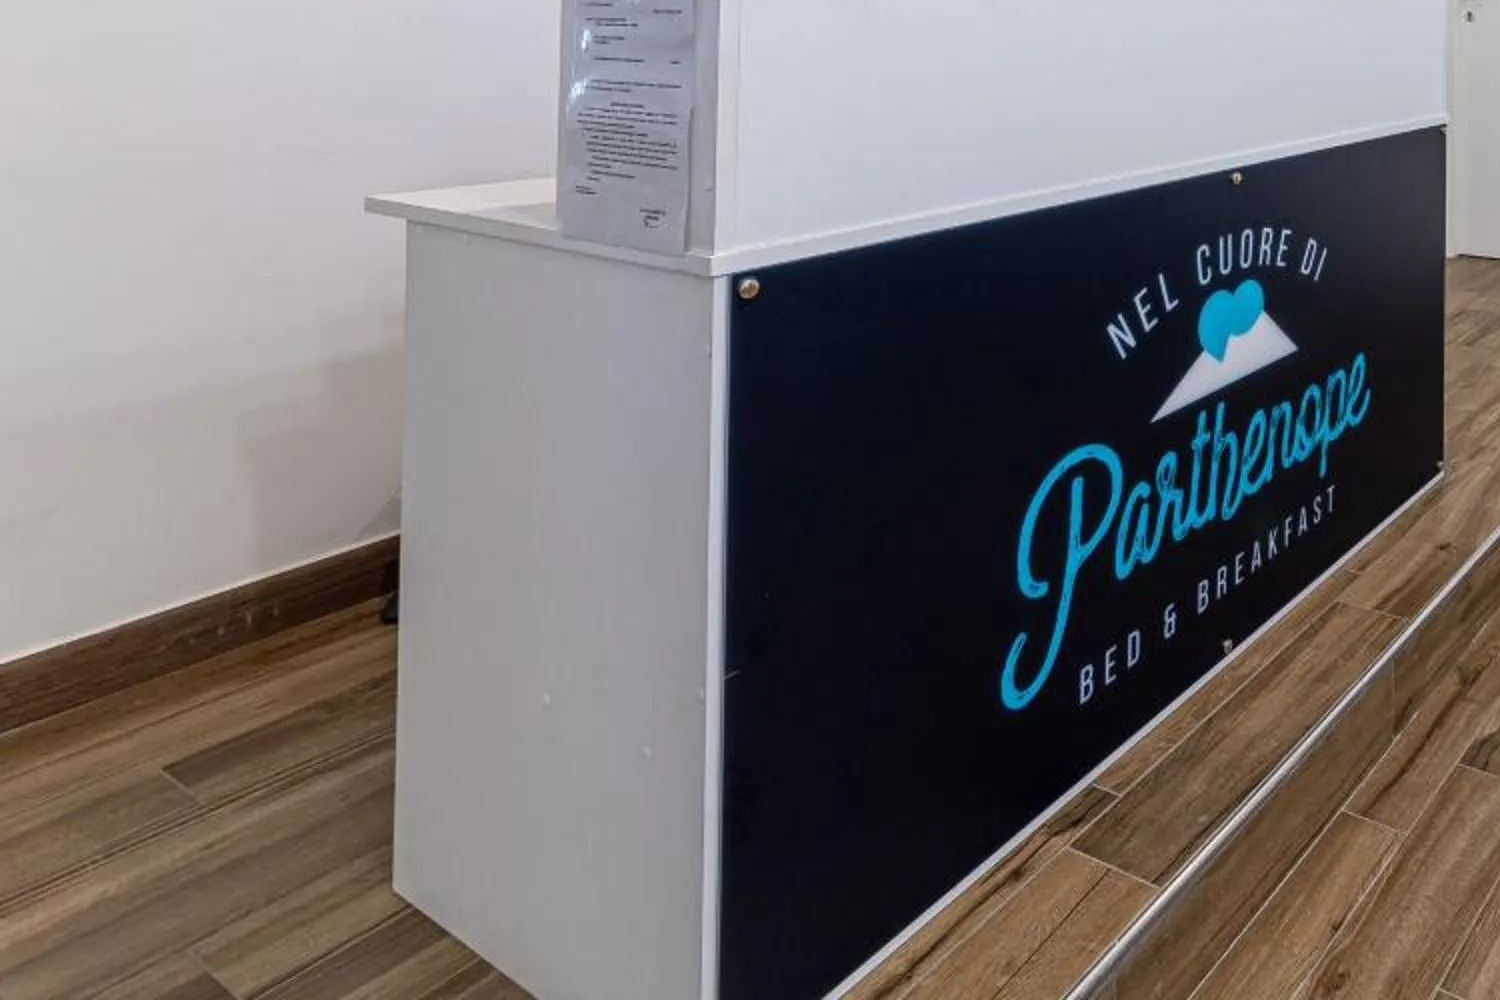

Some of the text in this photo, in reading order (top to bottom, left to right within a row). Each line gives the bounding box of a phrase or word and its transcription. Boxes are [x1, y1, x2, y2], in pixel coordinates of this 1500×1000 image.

[1105, 226, 1328, 361] NEL CUORE DI
[1000, 351, 1372, 711] Parthenope
[1078, 484, 1337, 705] BED & BREAKFAST
